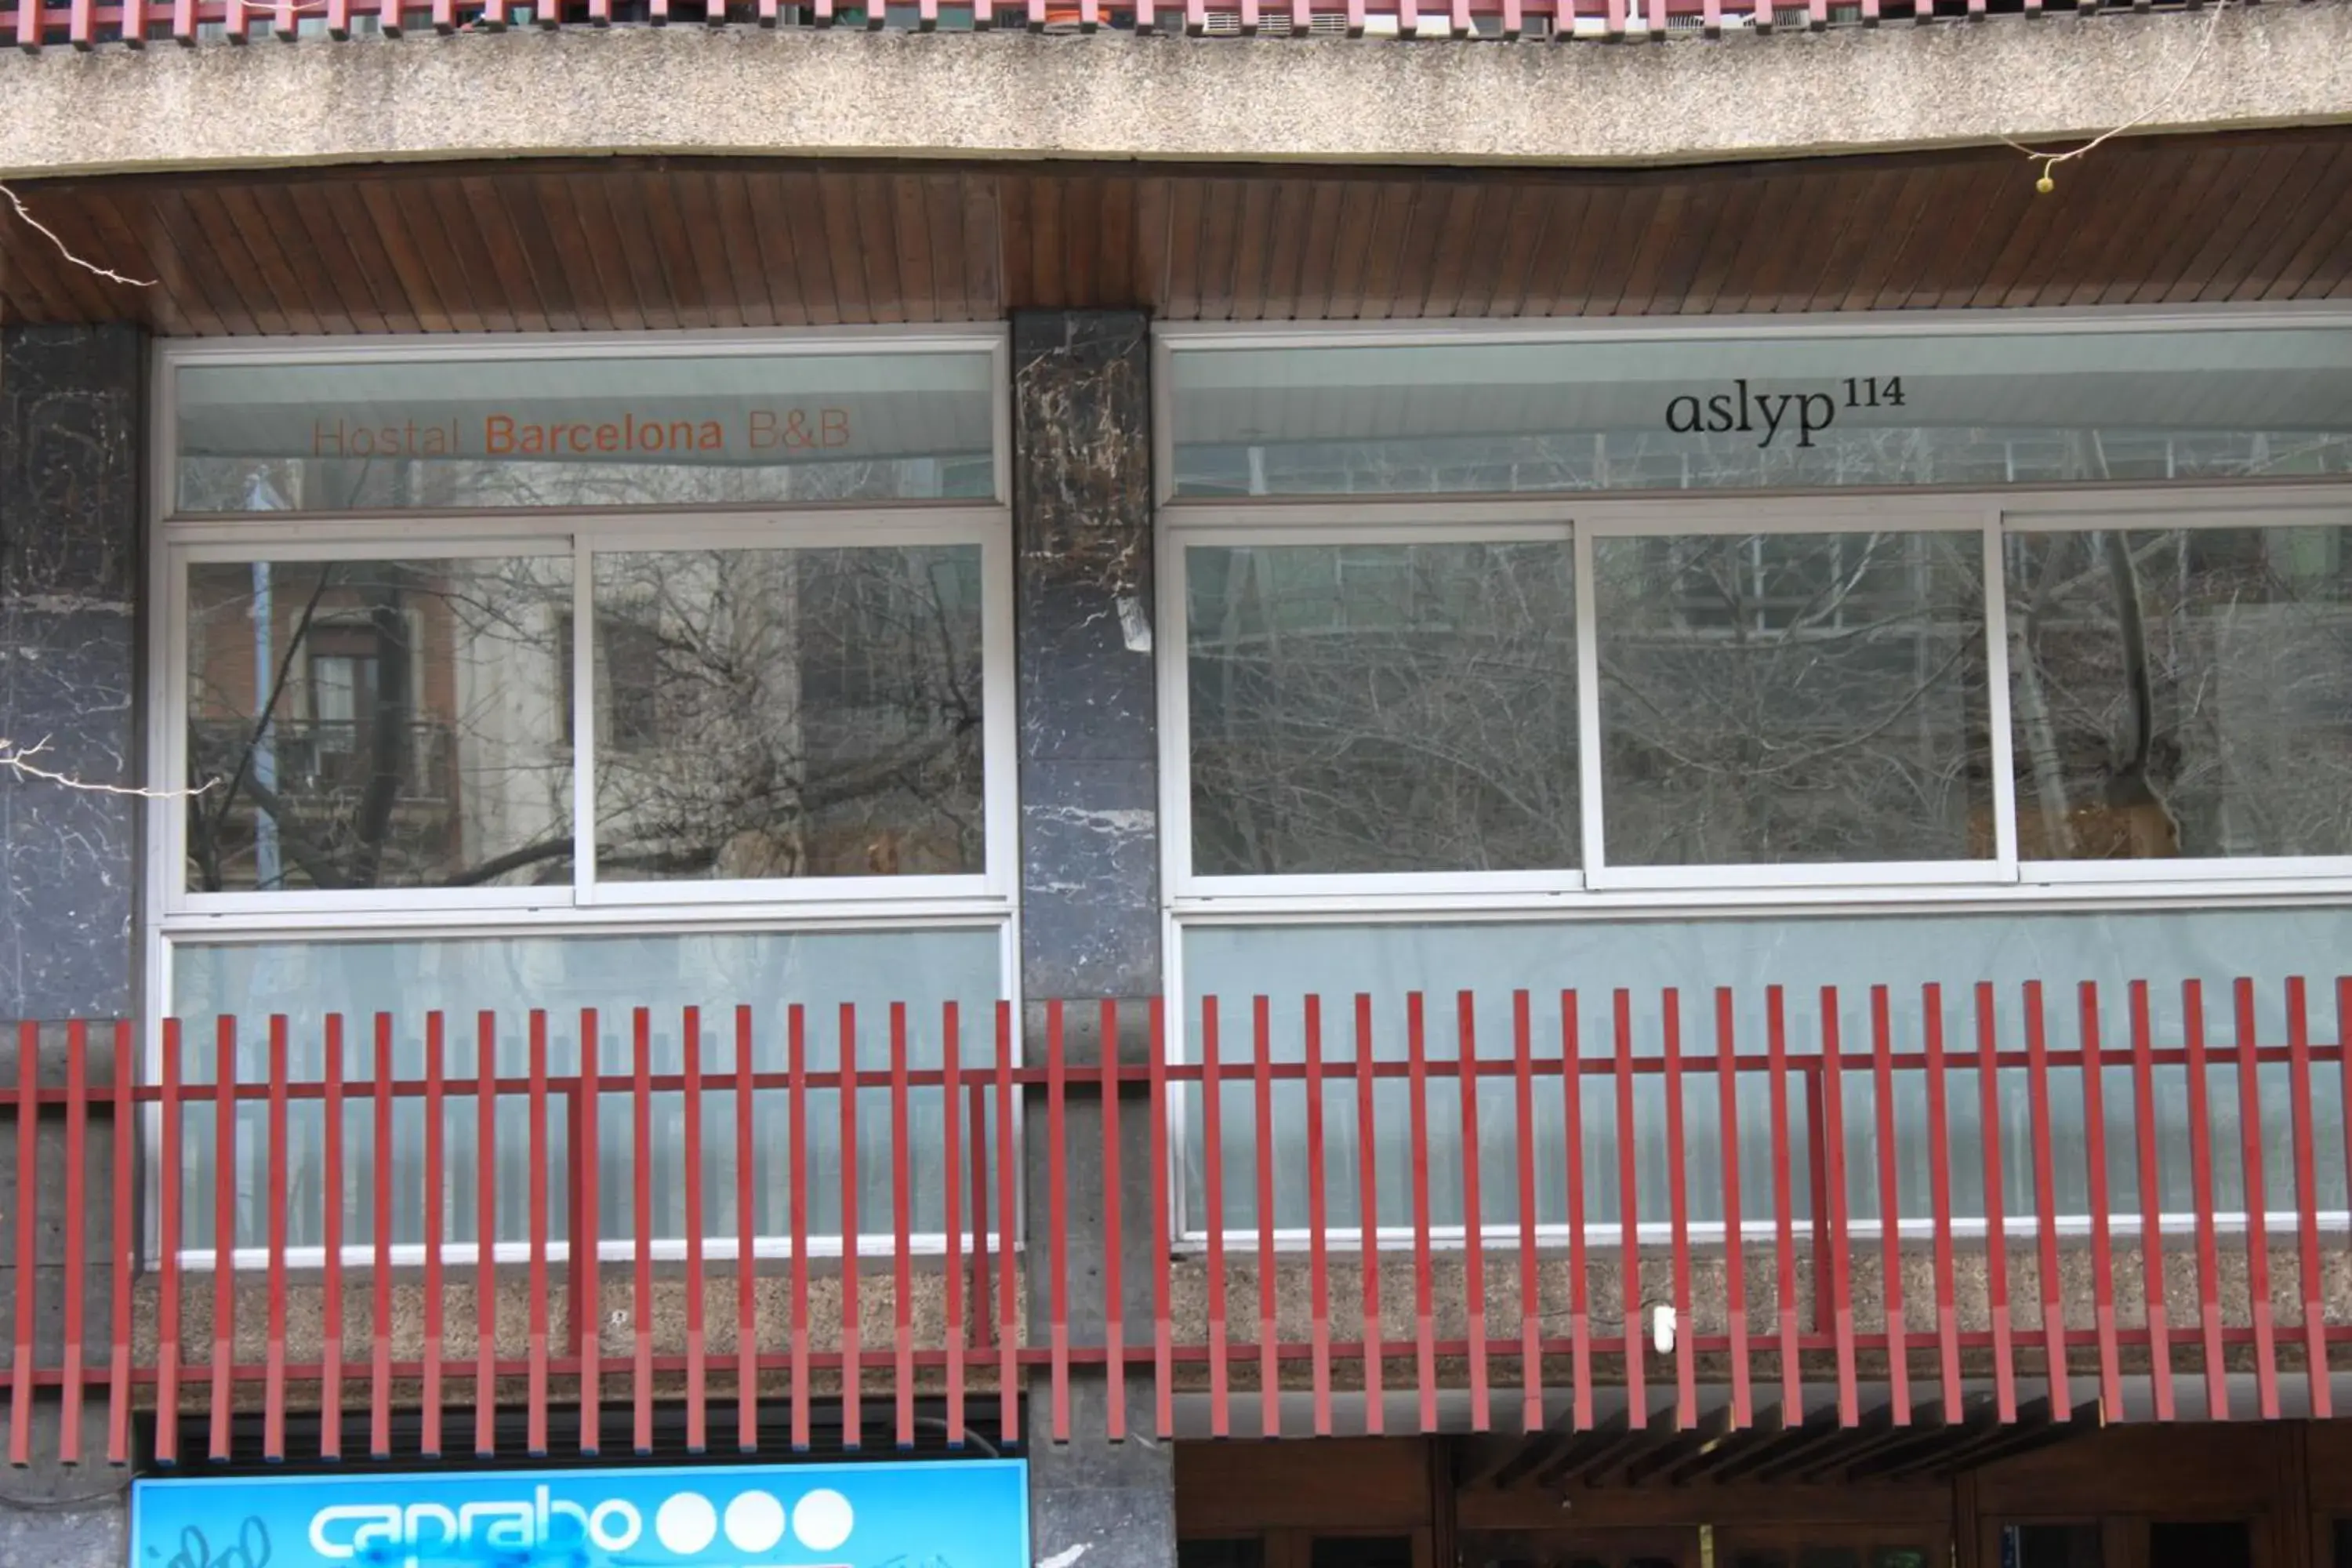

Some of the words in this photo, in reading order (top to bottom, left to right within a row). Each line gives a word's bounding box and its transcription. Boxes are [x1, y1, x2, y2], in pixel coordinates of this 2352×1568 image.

[314, 417, 459, 458] Hostal
[485, 413, 722, 454] Barcelona
[749, 408, 851, 449] B&B
[1665, 379, 1835, 448] aslyp
[308, 1484, 643, 1568] caprabo
